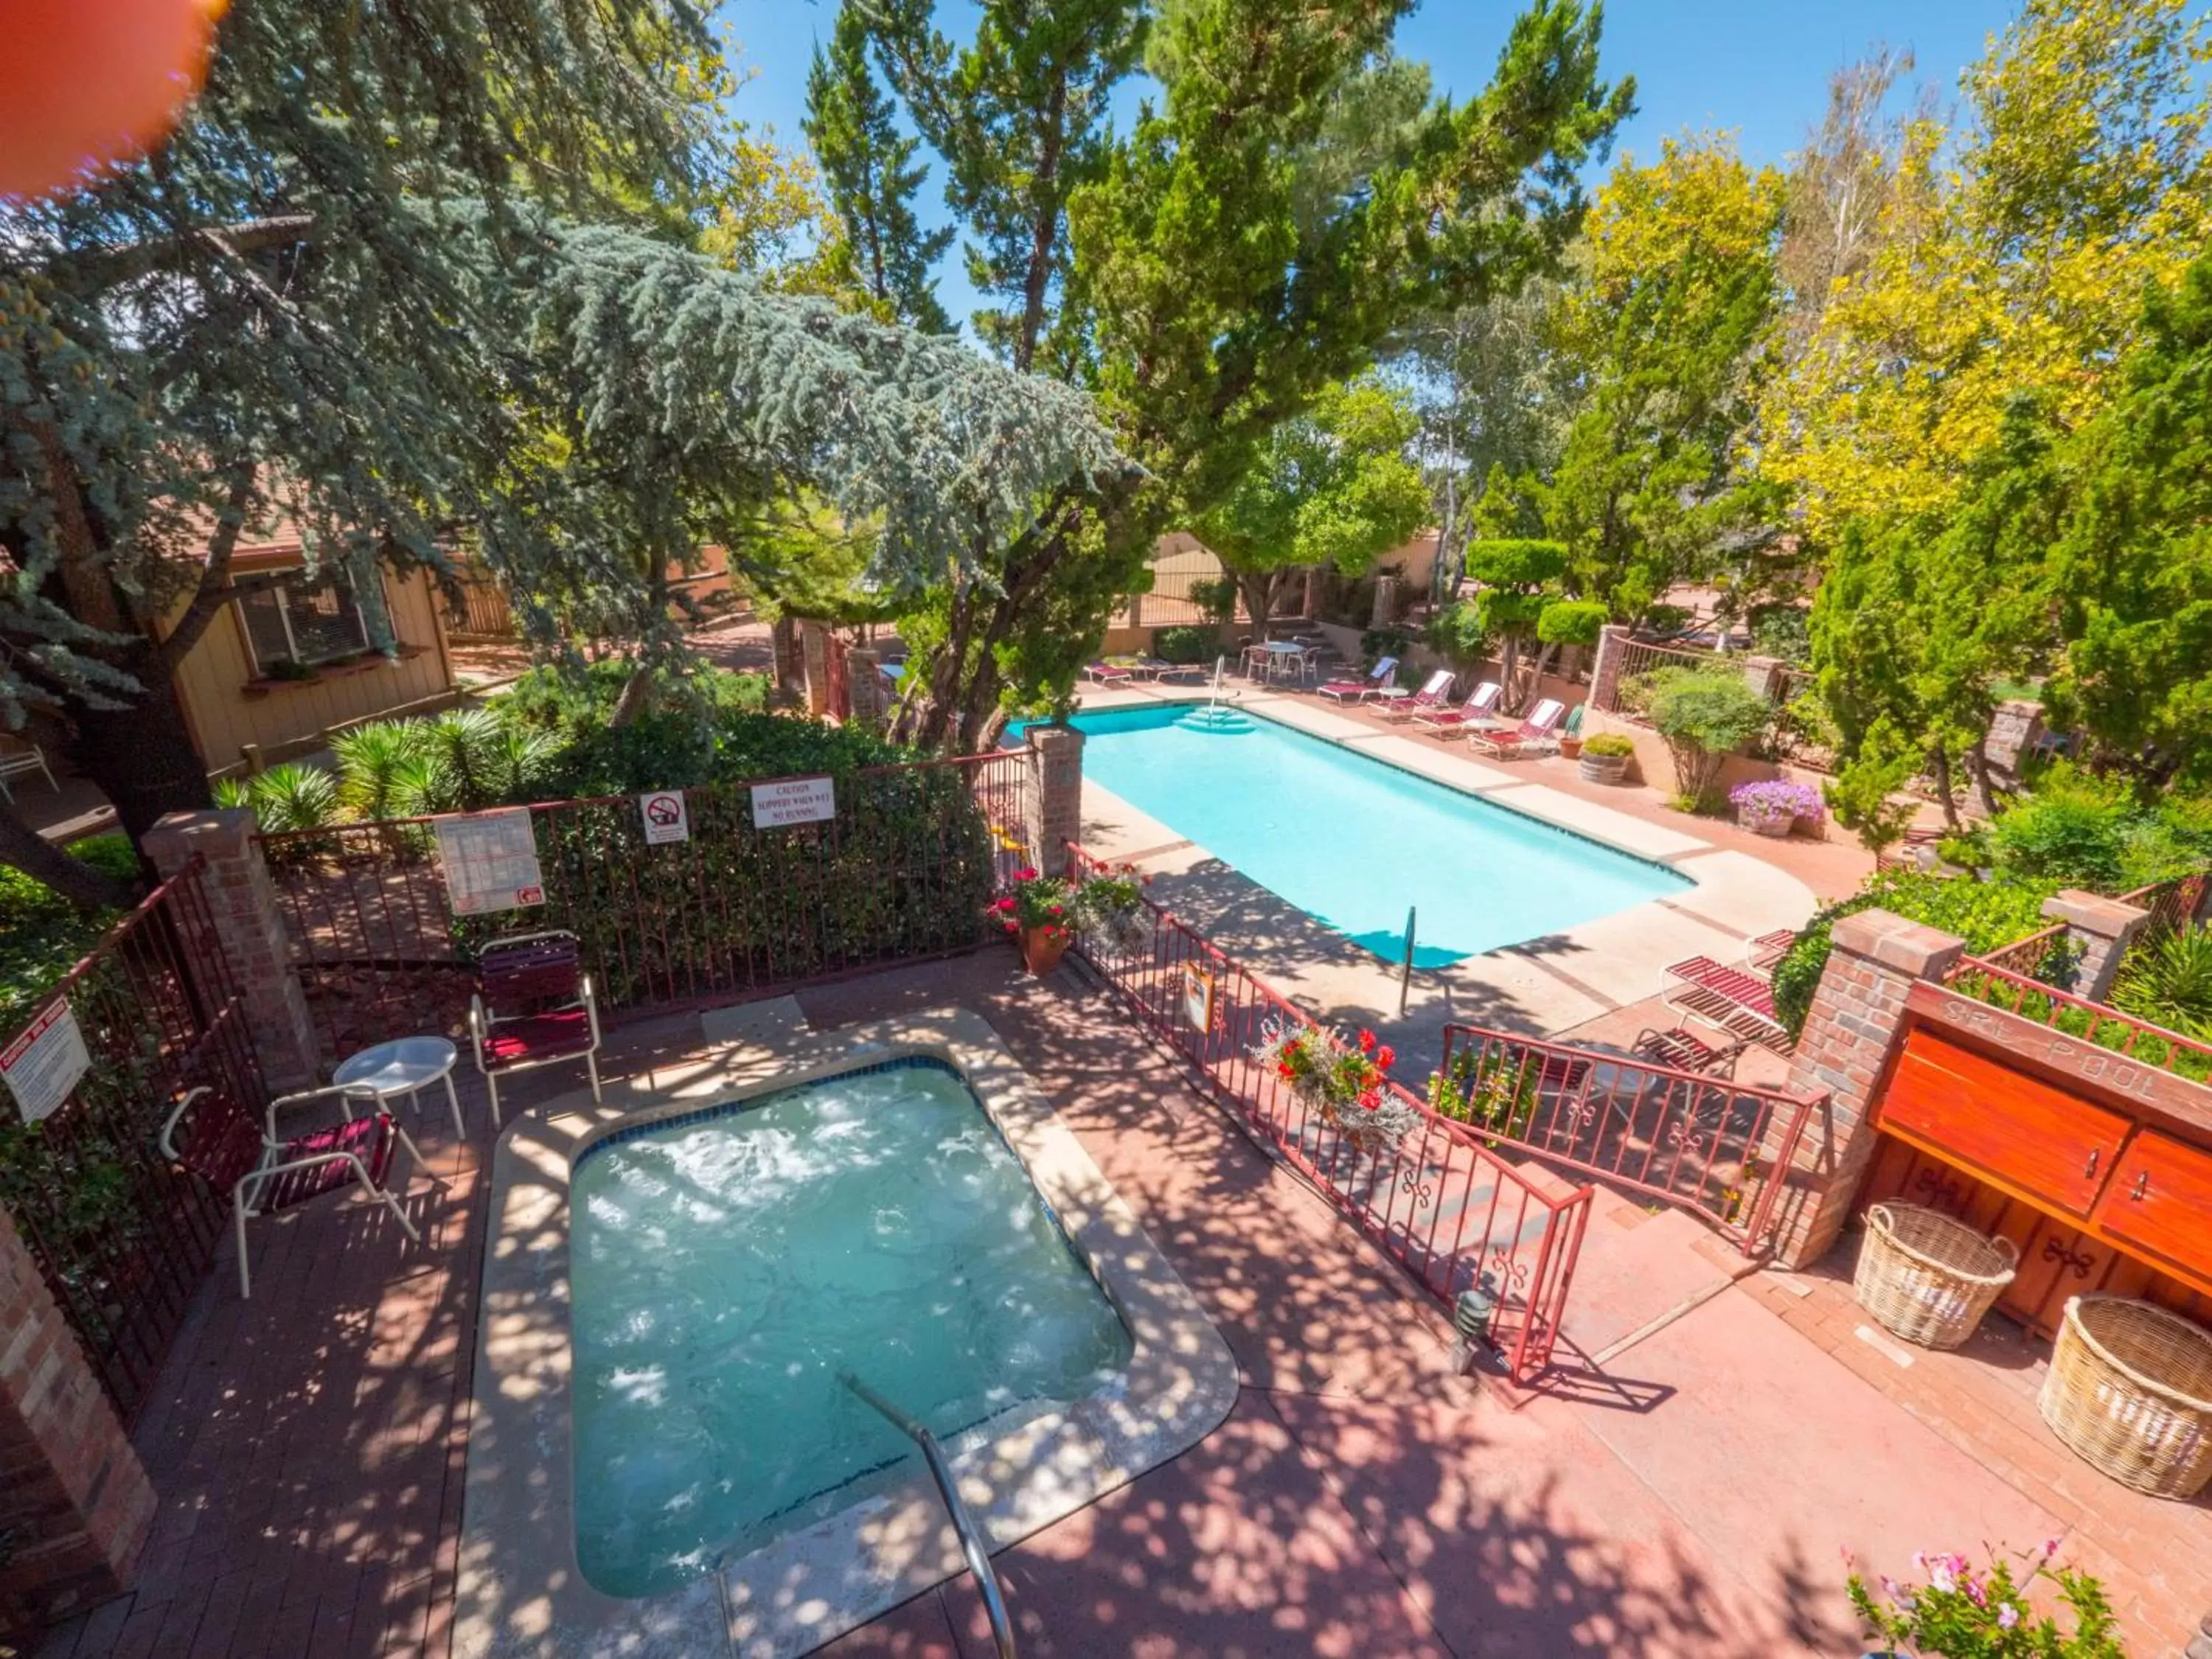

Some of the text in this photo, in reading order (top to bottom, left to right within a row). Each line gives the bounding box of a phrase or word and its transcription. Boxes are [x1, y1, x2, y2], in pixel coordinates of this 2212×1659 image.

[776, 784, 810, 796] CAUTION
[772, 810, 784, 821] NO
[2047, 1039, 2160, 1102] POOL
